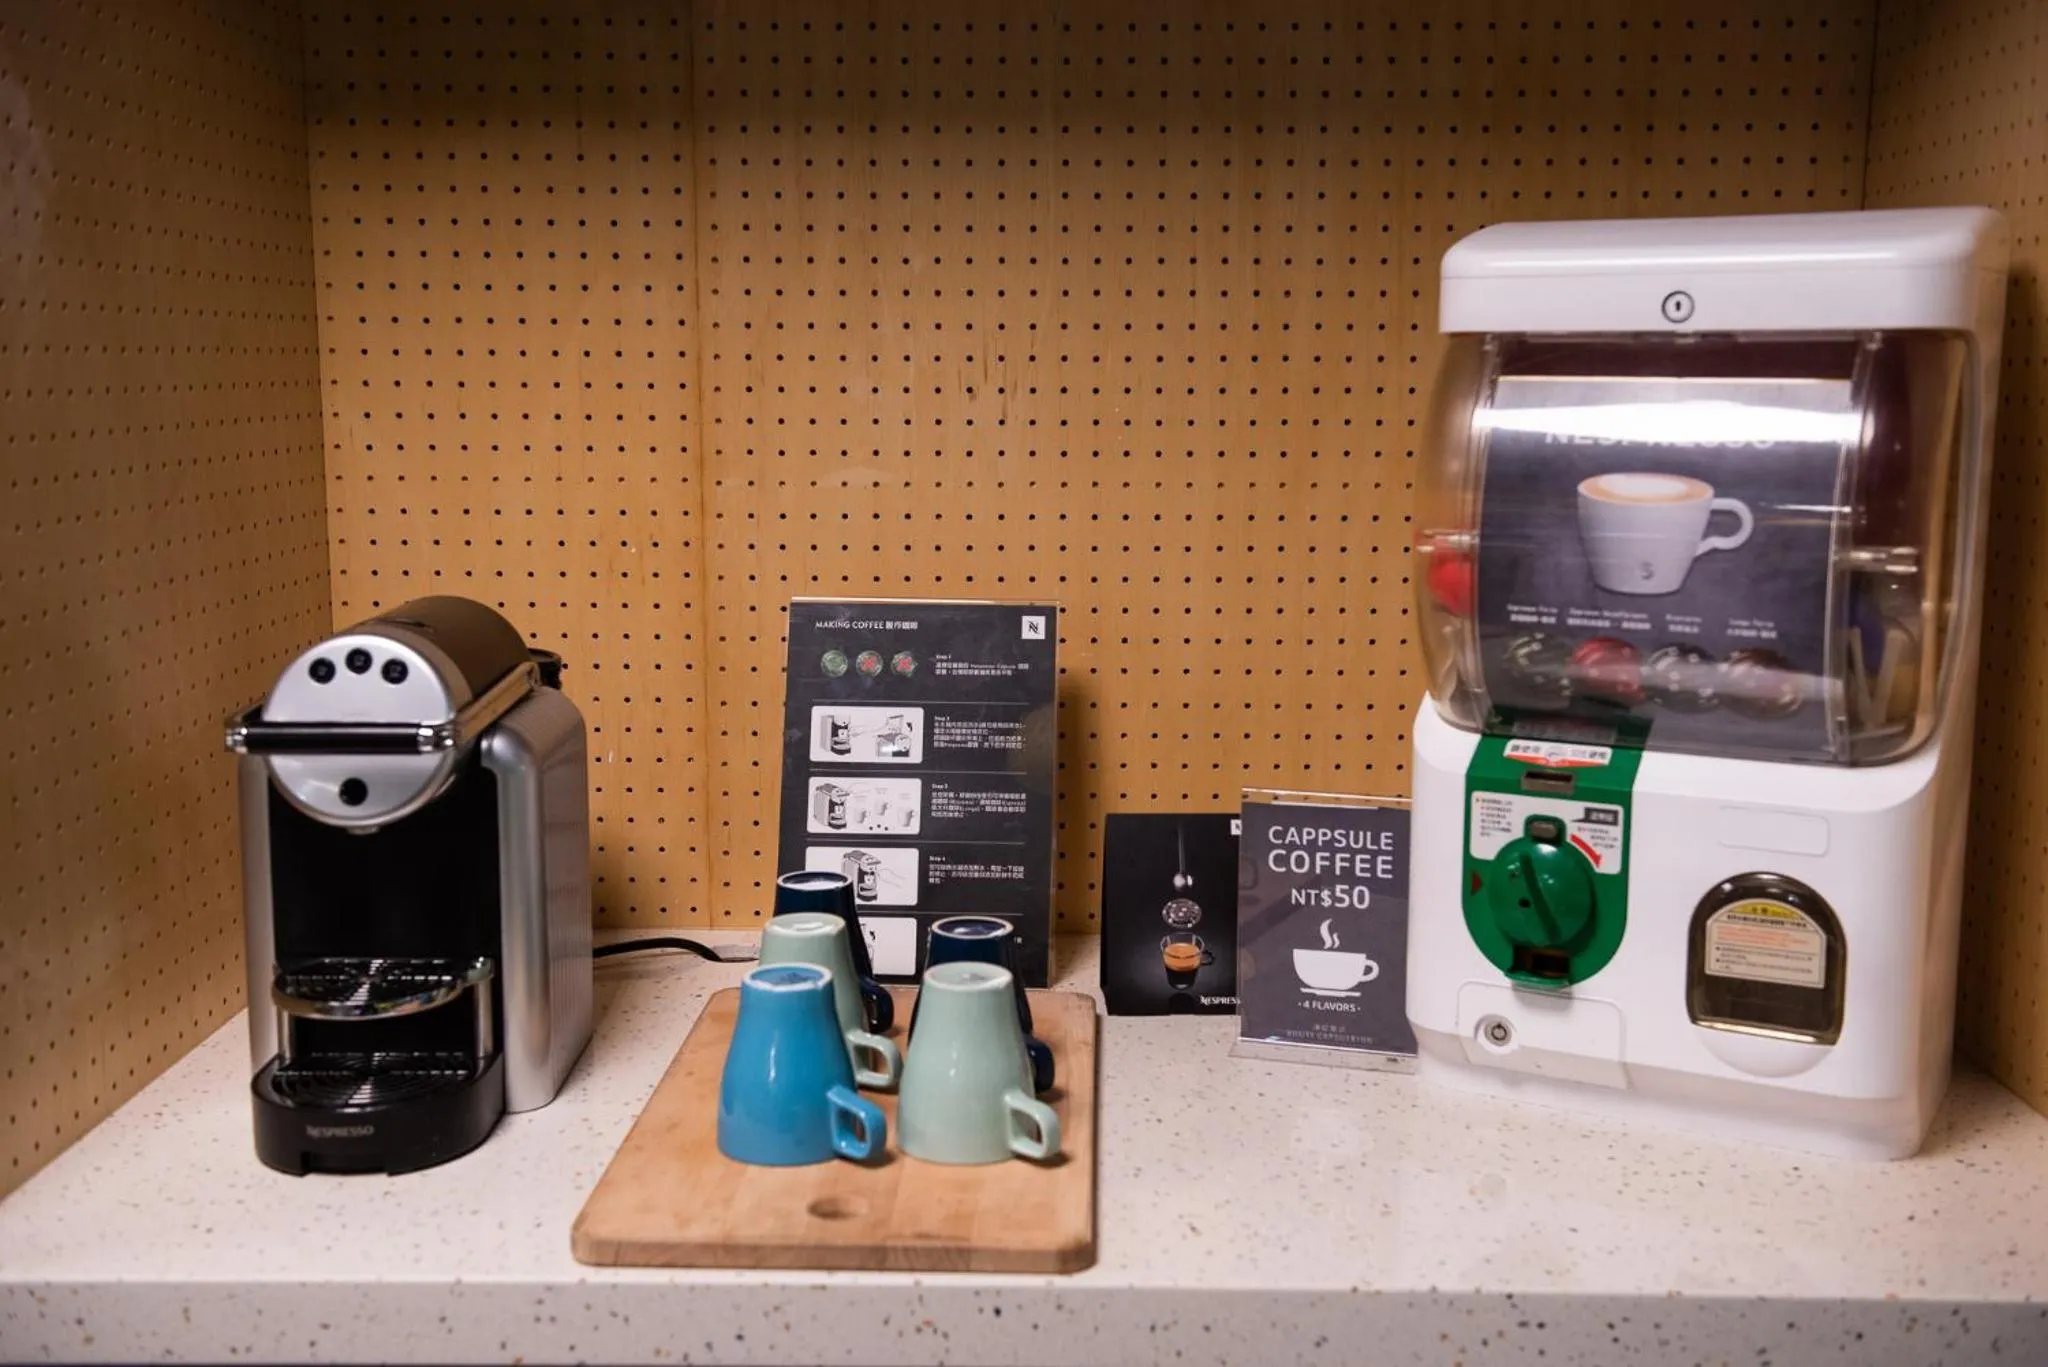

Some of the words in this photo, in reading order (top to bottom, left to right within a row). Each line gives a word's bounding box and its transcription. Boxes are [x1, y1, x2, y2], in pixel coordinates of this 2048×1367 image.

[815, 620, 850, 629] MAKING
[852, 620, 884, 629] COFFEE
[1268, 825, 1394, 850] CAPPSULE
[1267, 849, 1394, 879] COFFEE
[1290, 884, 1371, 910] NT$50
[1303, 1000, 1309, 1009] 4
[1312, 1001, 1357, 1013] FLAVORS
